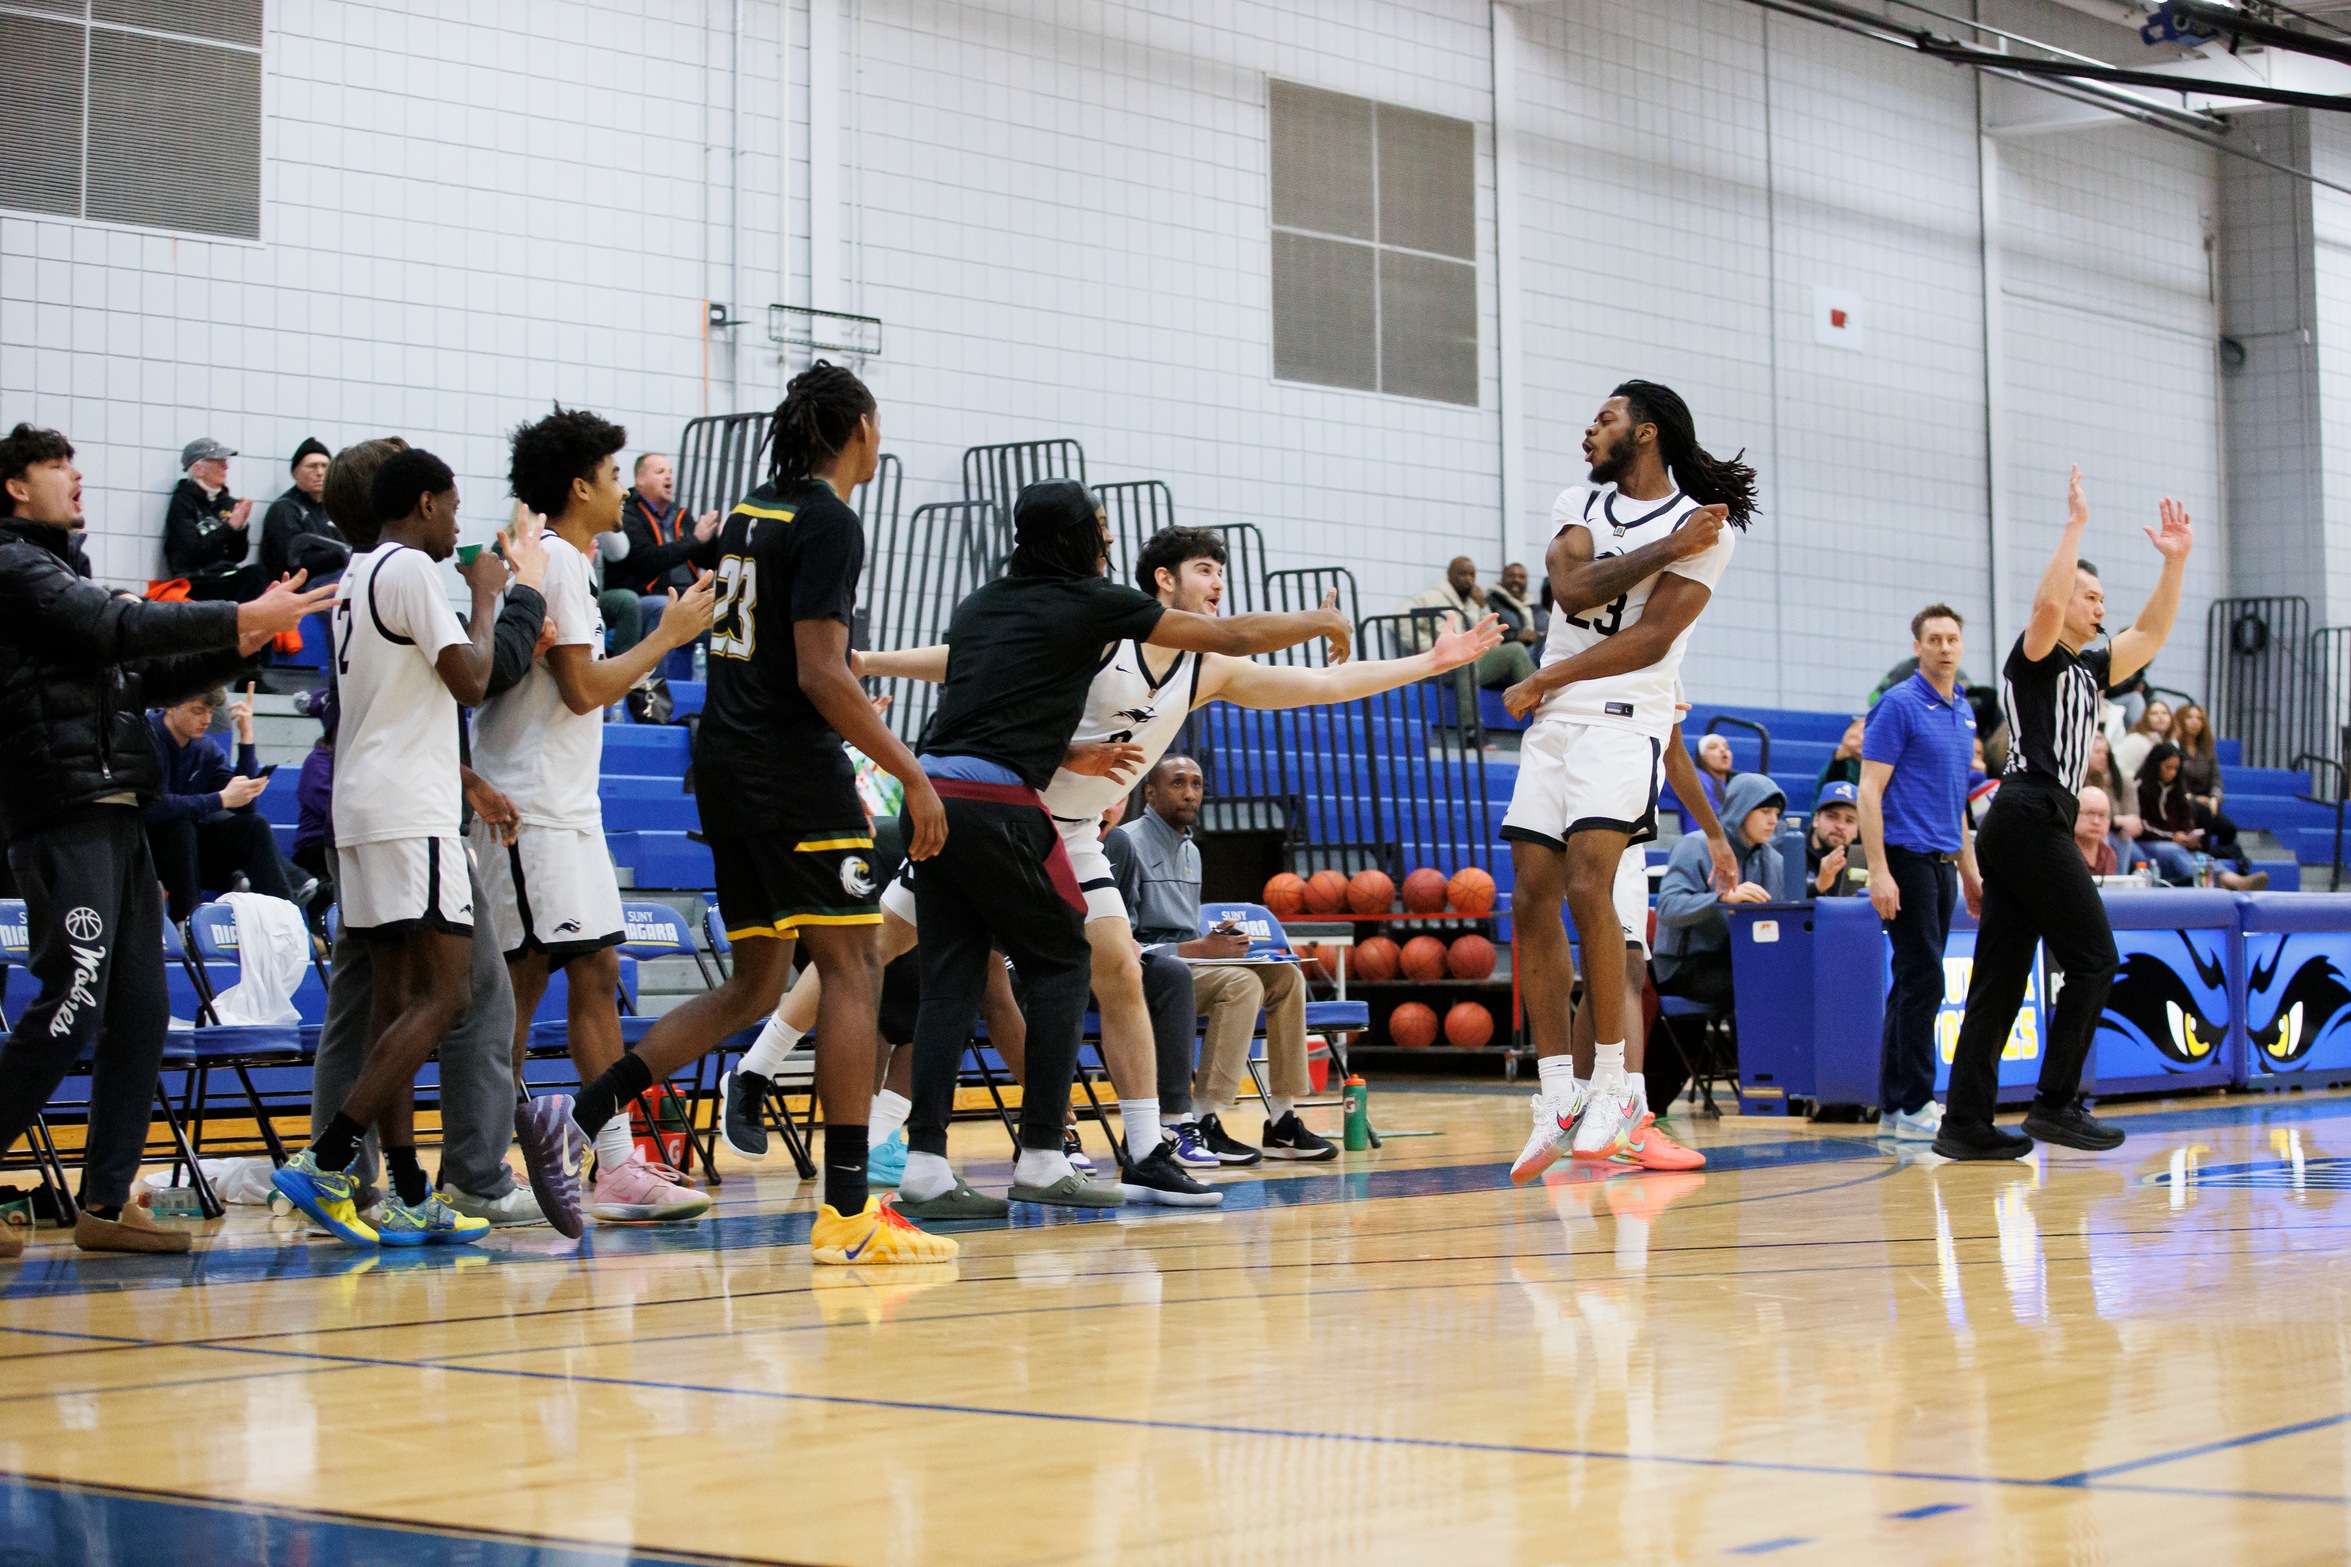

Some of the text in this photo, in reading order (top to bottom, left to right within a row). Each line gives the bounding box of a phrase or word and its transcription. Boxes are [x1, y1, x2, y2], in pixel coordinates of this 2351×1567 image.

[710, 554, 757, 661] 23
[627, 910, 653, 923] SUNY
[1221, 910, 1247, 921] SUNY
[50, 943, 107, 1038] Wolves
